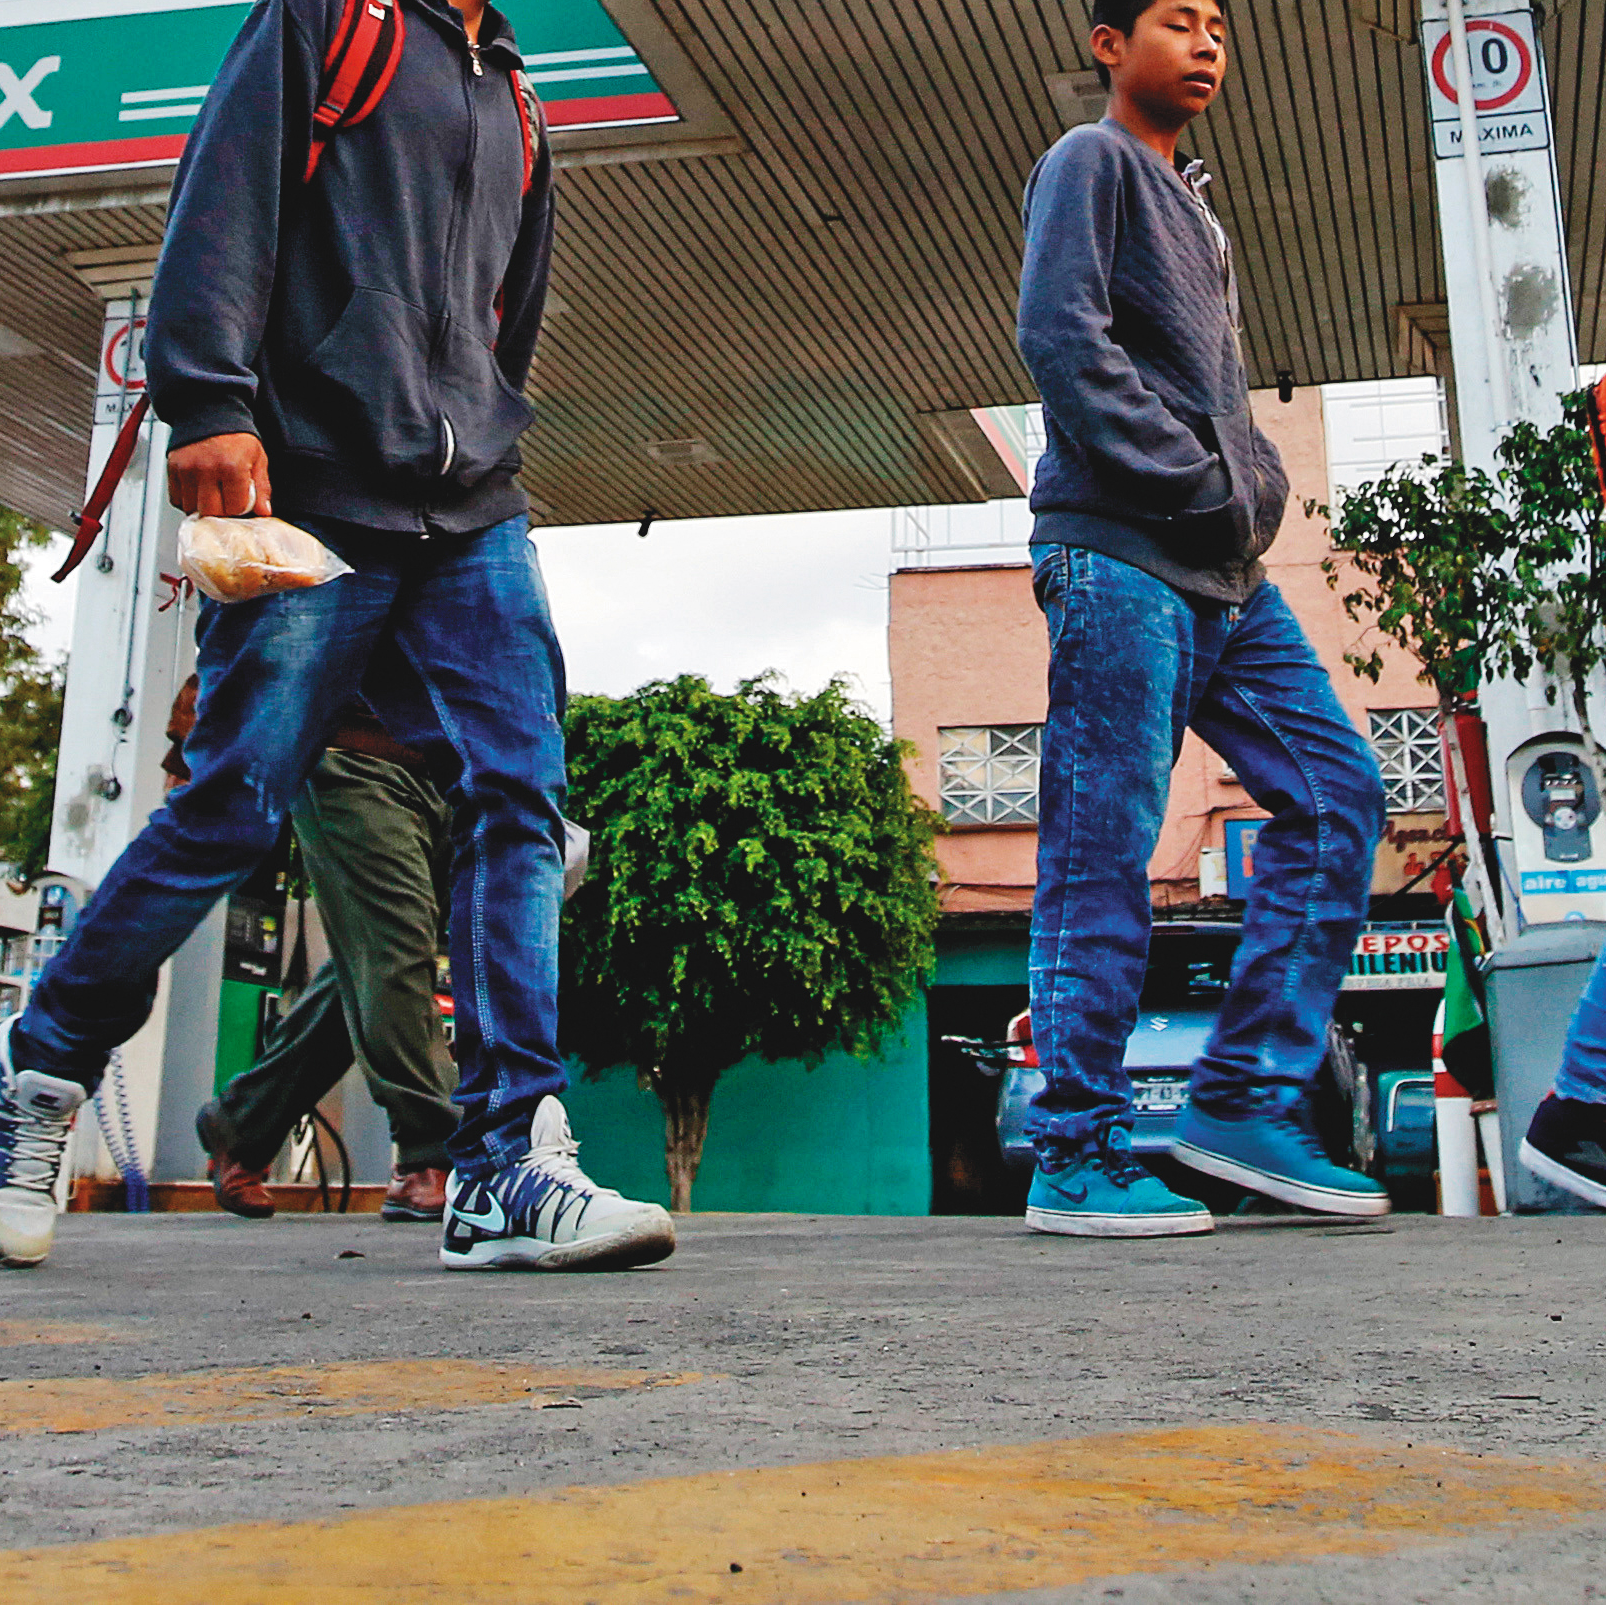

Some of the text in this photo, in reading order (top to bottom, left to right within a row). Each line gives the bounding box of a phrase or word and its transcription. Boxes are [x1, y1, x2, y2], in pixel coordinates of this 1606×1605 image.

[1465, 37, 1508, 74] 0
[1450, 123, 1534, 143] MXIMA
[1523, 879, 1567, 891] aire
[1355, 934, 1450, 954] EPOS
